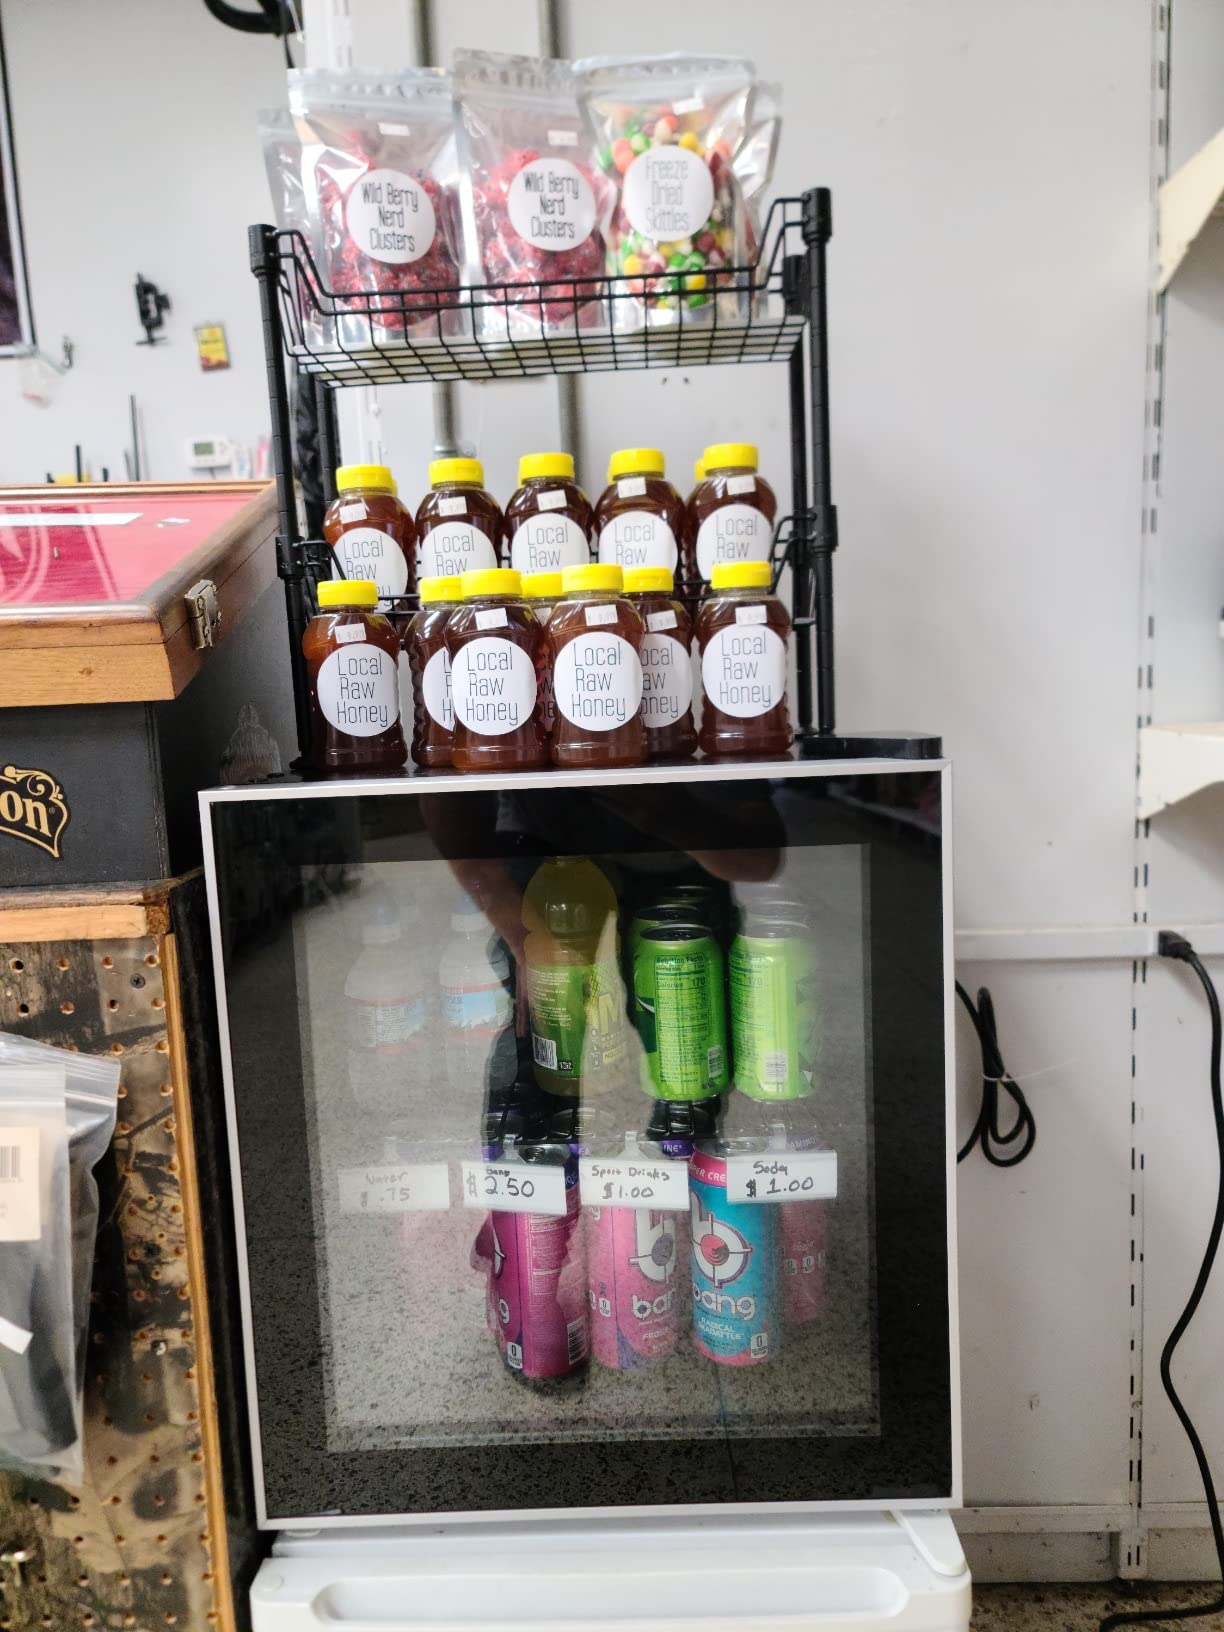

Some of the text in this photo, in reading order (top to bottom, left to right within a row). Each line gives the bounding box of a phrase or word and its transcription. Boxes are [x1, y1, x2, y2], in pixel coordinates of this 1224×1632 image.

[645, 156, 688, 179] Freeze
[362, 182, 418, 212] Wild Berry
[523, 171, 580, 200] Wild Berry
[652, 181, 682, 206] Dried
[540, 193, 565, 216] Nerd
[378, 206, 404, 228] Nerd
[531, 216, 575, 239] Clusters
[646, 207, 689, 233] Skittles
[370, 228, 415, 252] Clusters
[527, 522, 569, 546] Local
[614, 519, 655, 544] Local
[716, 514, 758, 537] Local
[343, 535, 384, 560] Local
[433, 530, 475, 555] Local
[615, 543, 648, 566] Raw
[717, 536, 751, 559] Raw
[436, 554, 468, 577] Raw
[529, 546, 561, 568] Raw
[345, 560, 377, 580] Raw
[574, 641, 621, 667] Local
[721, 631, 767, 657] Local
[337, 652, 383, 676] Local
[466, 646, 513, 672] Local
[722, 657, 759, 681] Raw
[339, 676, 375, 700] Raw
[468, 672, 504, 697] Raw
[576, 667, 613, 692] Raw
[643, 672, 666, 691] aw
[719, 681, 772, 709] Honey
[336, 700, 388, 728] Honey
[465, 697, 518, 726] Honey
[571, 693, 626, 722] Honey
[641, 696, 679, 719] oney
[466, 1171, 535, 1198] $ 2.50
[628, 1167, 671, 1181] Drinks
[379, 1187, 410, 1202] .75
[745, 1176, 814, 1198] $ 1.00
